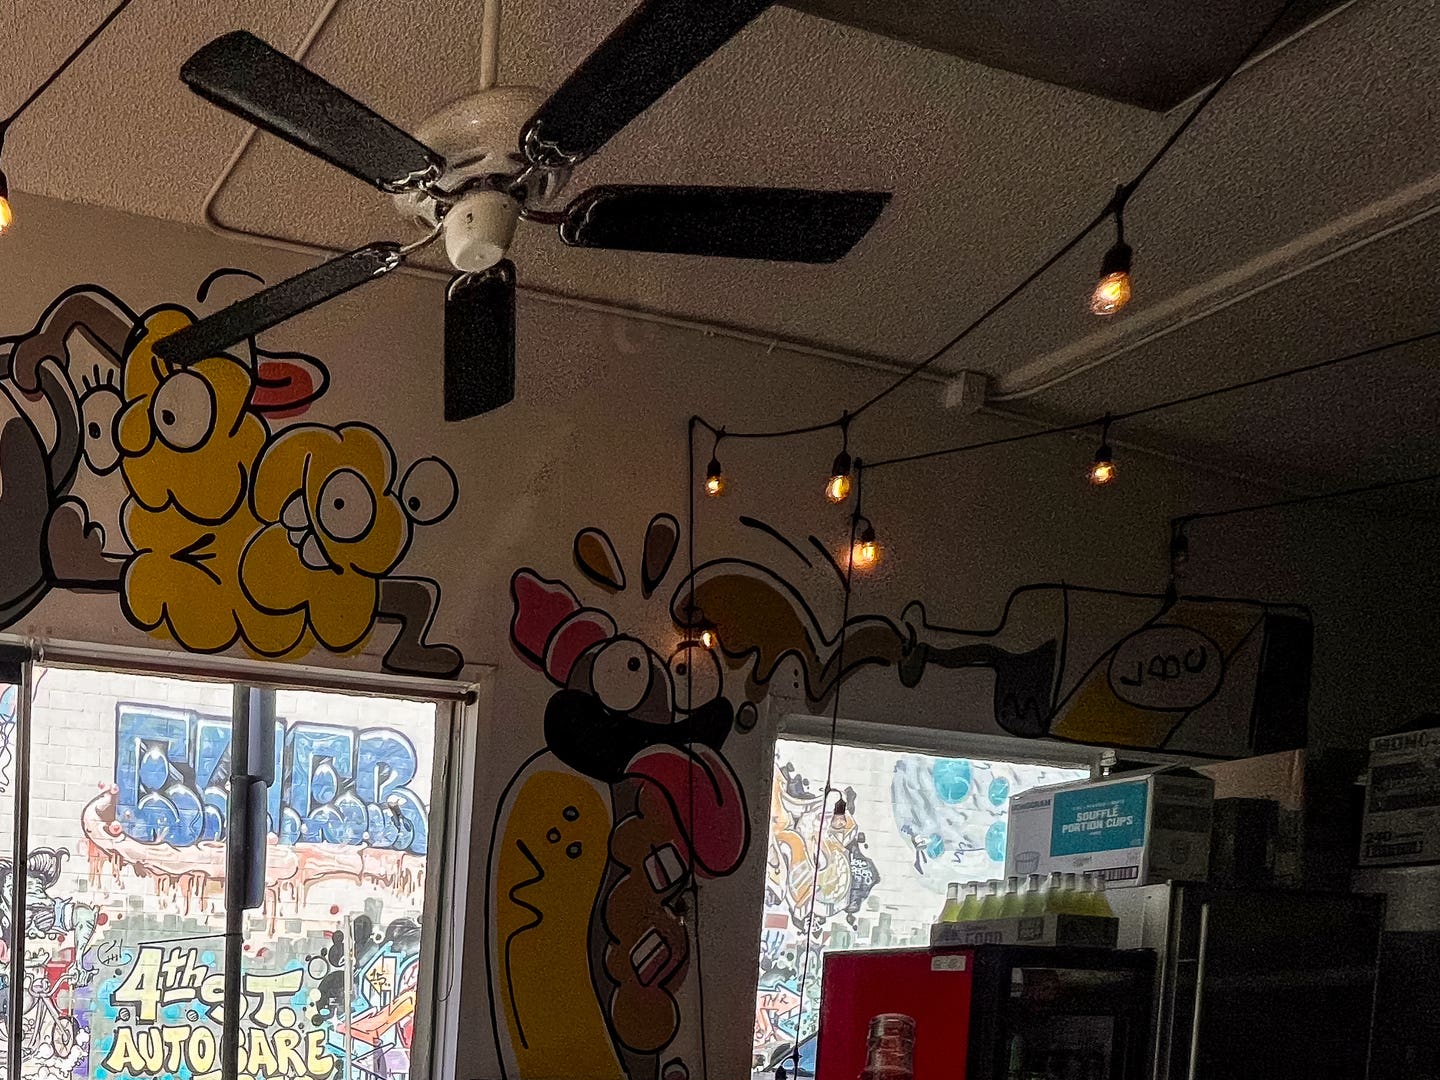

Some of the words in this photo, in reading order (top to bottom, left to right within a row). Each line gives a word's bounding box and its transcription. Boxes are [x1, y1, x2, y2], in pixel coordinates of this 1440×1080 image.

[1119, 644, 1208, 690] LBC
[1062, 818, 1104, 833] PORTION
[1106, 815, 1134, 828] CUPS
[1076, 803, 1119, 822] SOUFFLÉ
[111, 946, 209, 1025] 4th
[101, 1025, 216, 1076] AUTO
